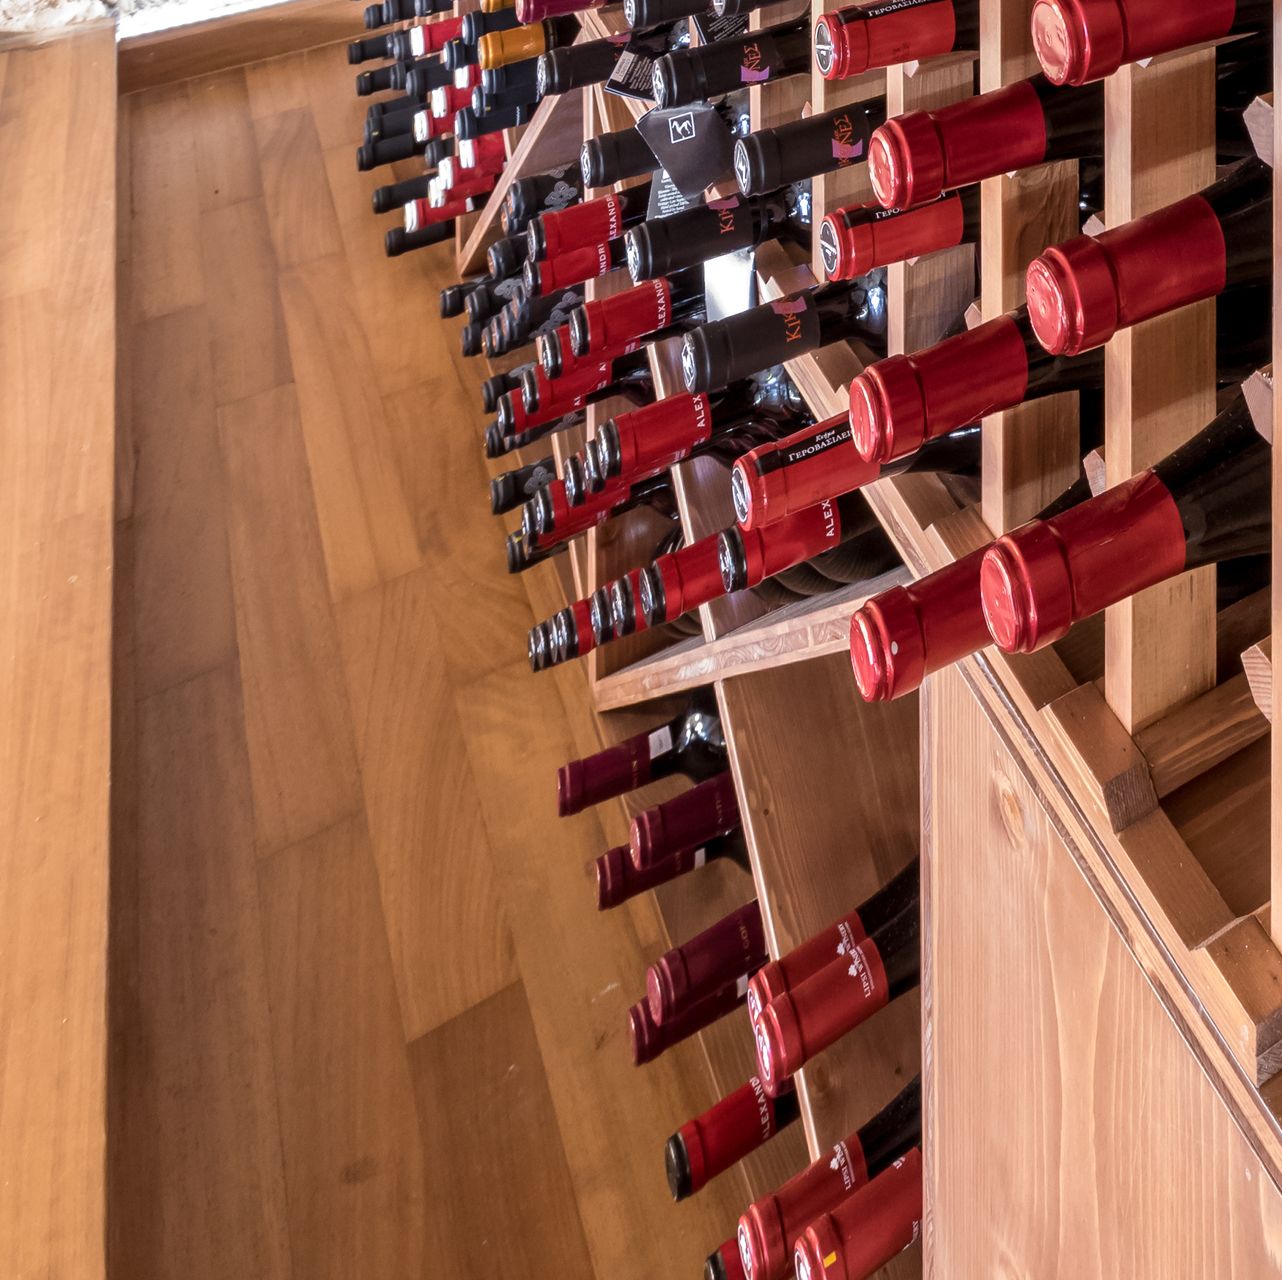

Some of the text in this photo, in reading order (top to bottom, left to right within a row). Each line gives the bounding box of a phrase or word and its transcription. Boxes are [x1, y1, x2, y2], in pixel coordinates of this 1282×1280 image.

[692, 393, 706, 428] ALEX
[821, 499, 835, 538] ALEX
[860, 971, 872, 999] LIPSI
[842, 1164, 853, 1191] LIPSI
